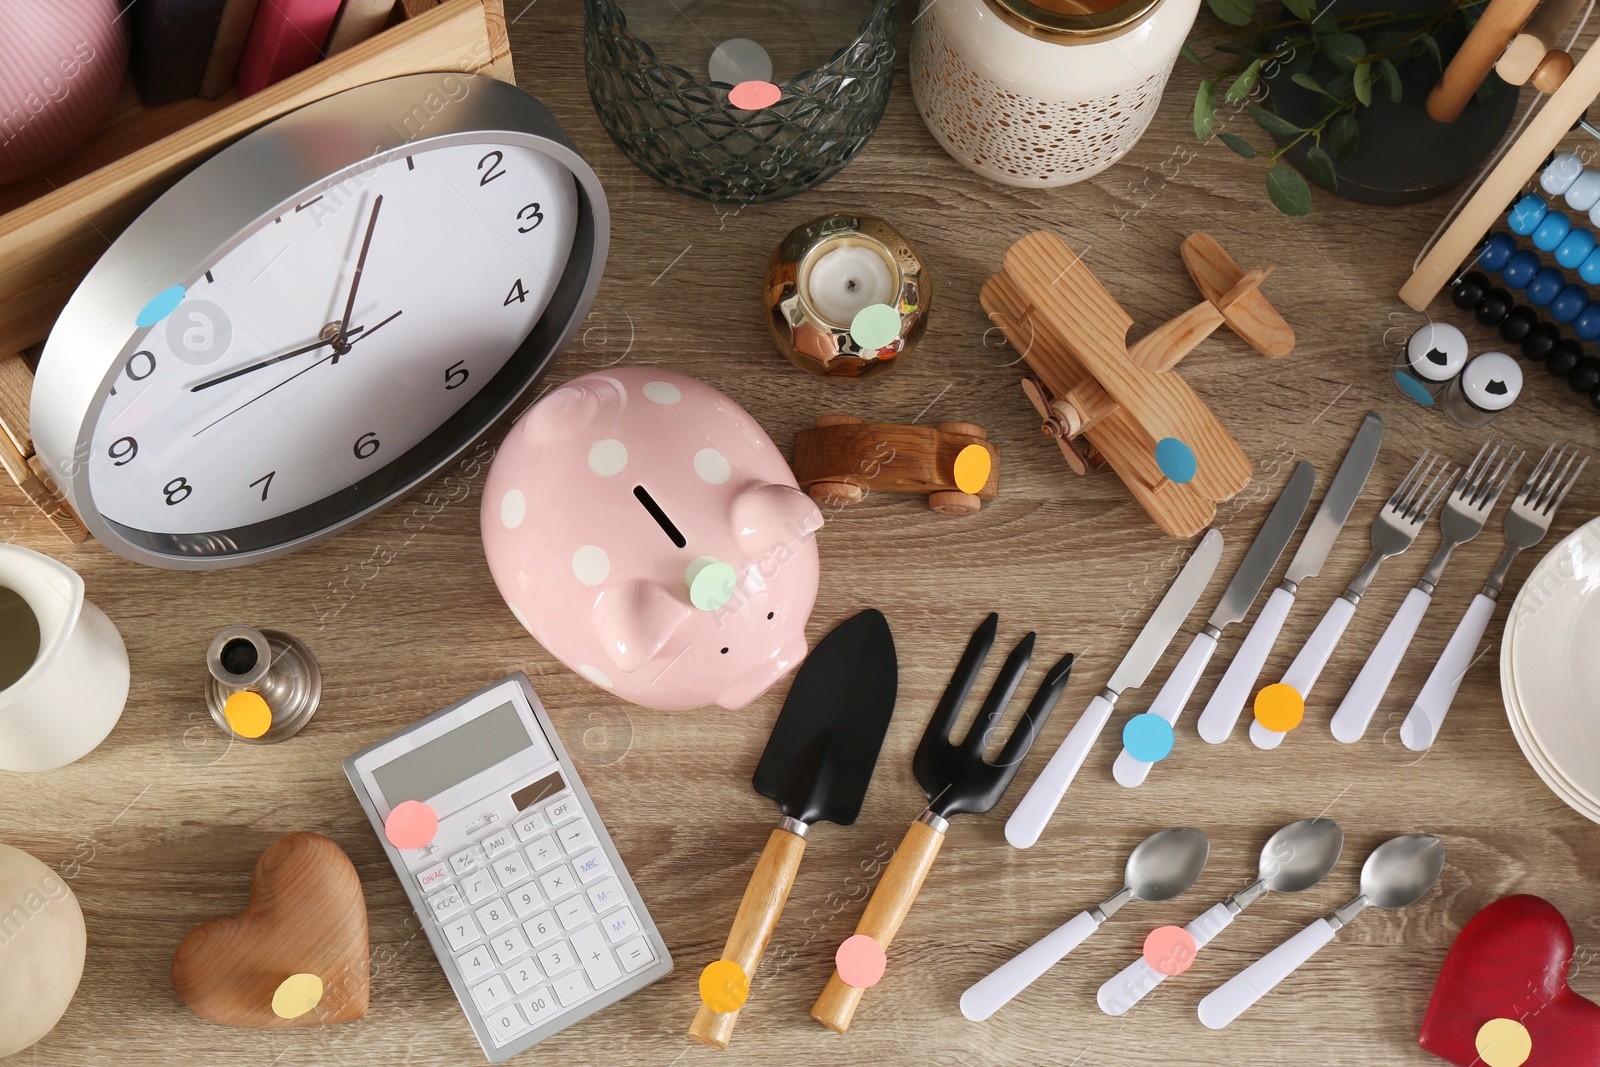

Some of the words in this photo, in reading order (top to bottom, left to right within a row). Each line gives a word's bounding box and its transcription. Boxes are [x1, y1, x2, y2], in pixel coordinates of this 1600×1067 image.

[477, 150, 507, 187] 2
[516, 202, 544, 234] 3
[503, 278, 530, 307] 4
[445, 359, 469, 390] 5
[108, 436, 139, 466] 9
[353, 431, 380, 460] 6
[163, 476, 193, 506] 8
[249, 471, 276, 502] 7
[553, 804, 569, 816] OFF
[523, 821, 536, 832] GT
[490, 837, 505, 849] MU
[580, 857, 600, 873] MRC
[422, 868, 445, 885] ON/AC
[436, 895, 457, 911] CE/C
[522, 893, 531, 905] 9
[489, 909, 499, 921] 8
[456, 925, 465, 937] 7
[537, 922, 547, 934] 6
[504, 939, 514, 951] 5
[472, 957, 481, 968] 4
[551, 953, 561, 965] 3
[519, 970, 529, 982] 2
[487, 987, 495, 998] 1
[530, 998, 546, 1012] 00
[501, 1017, 511, 1028] 0
